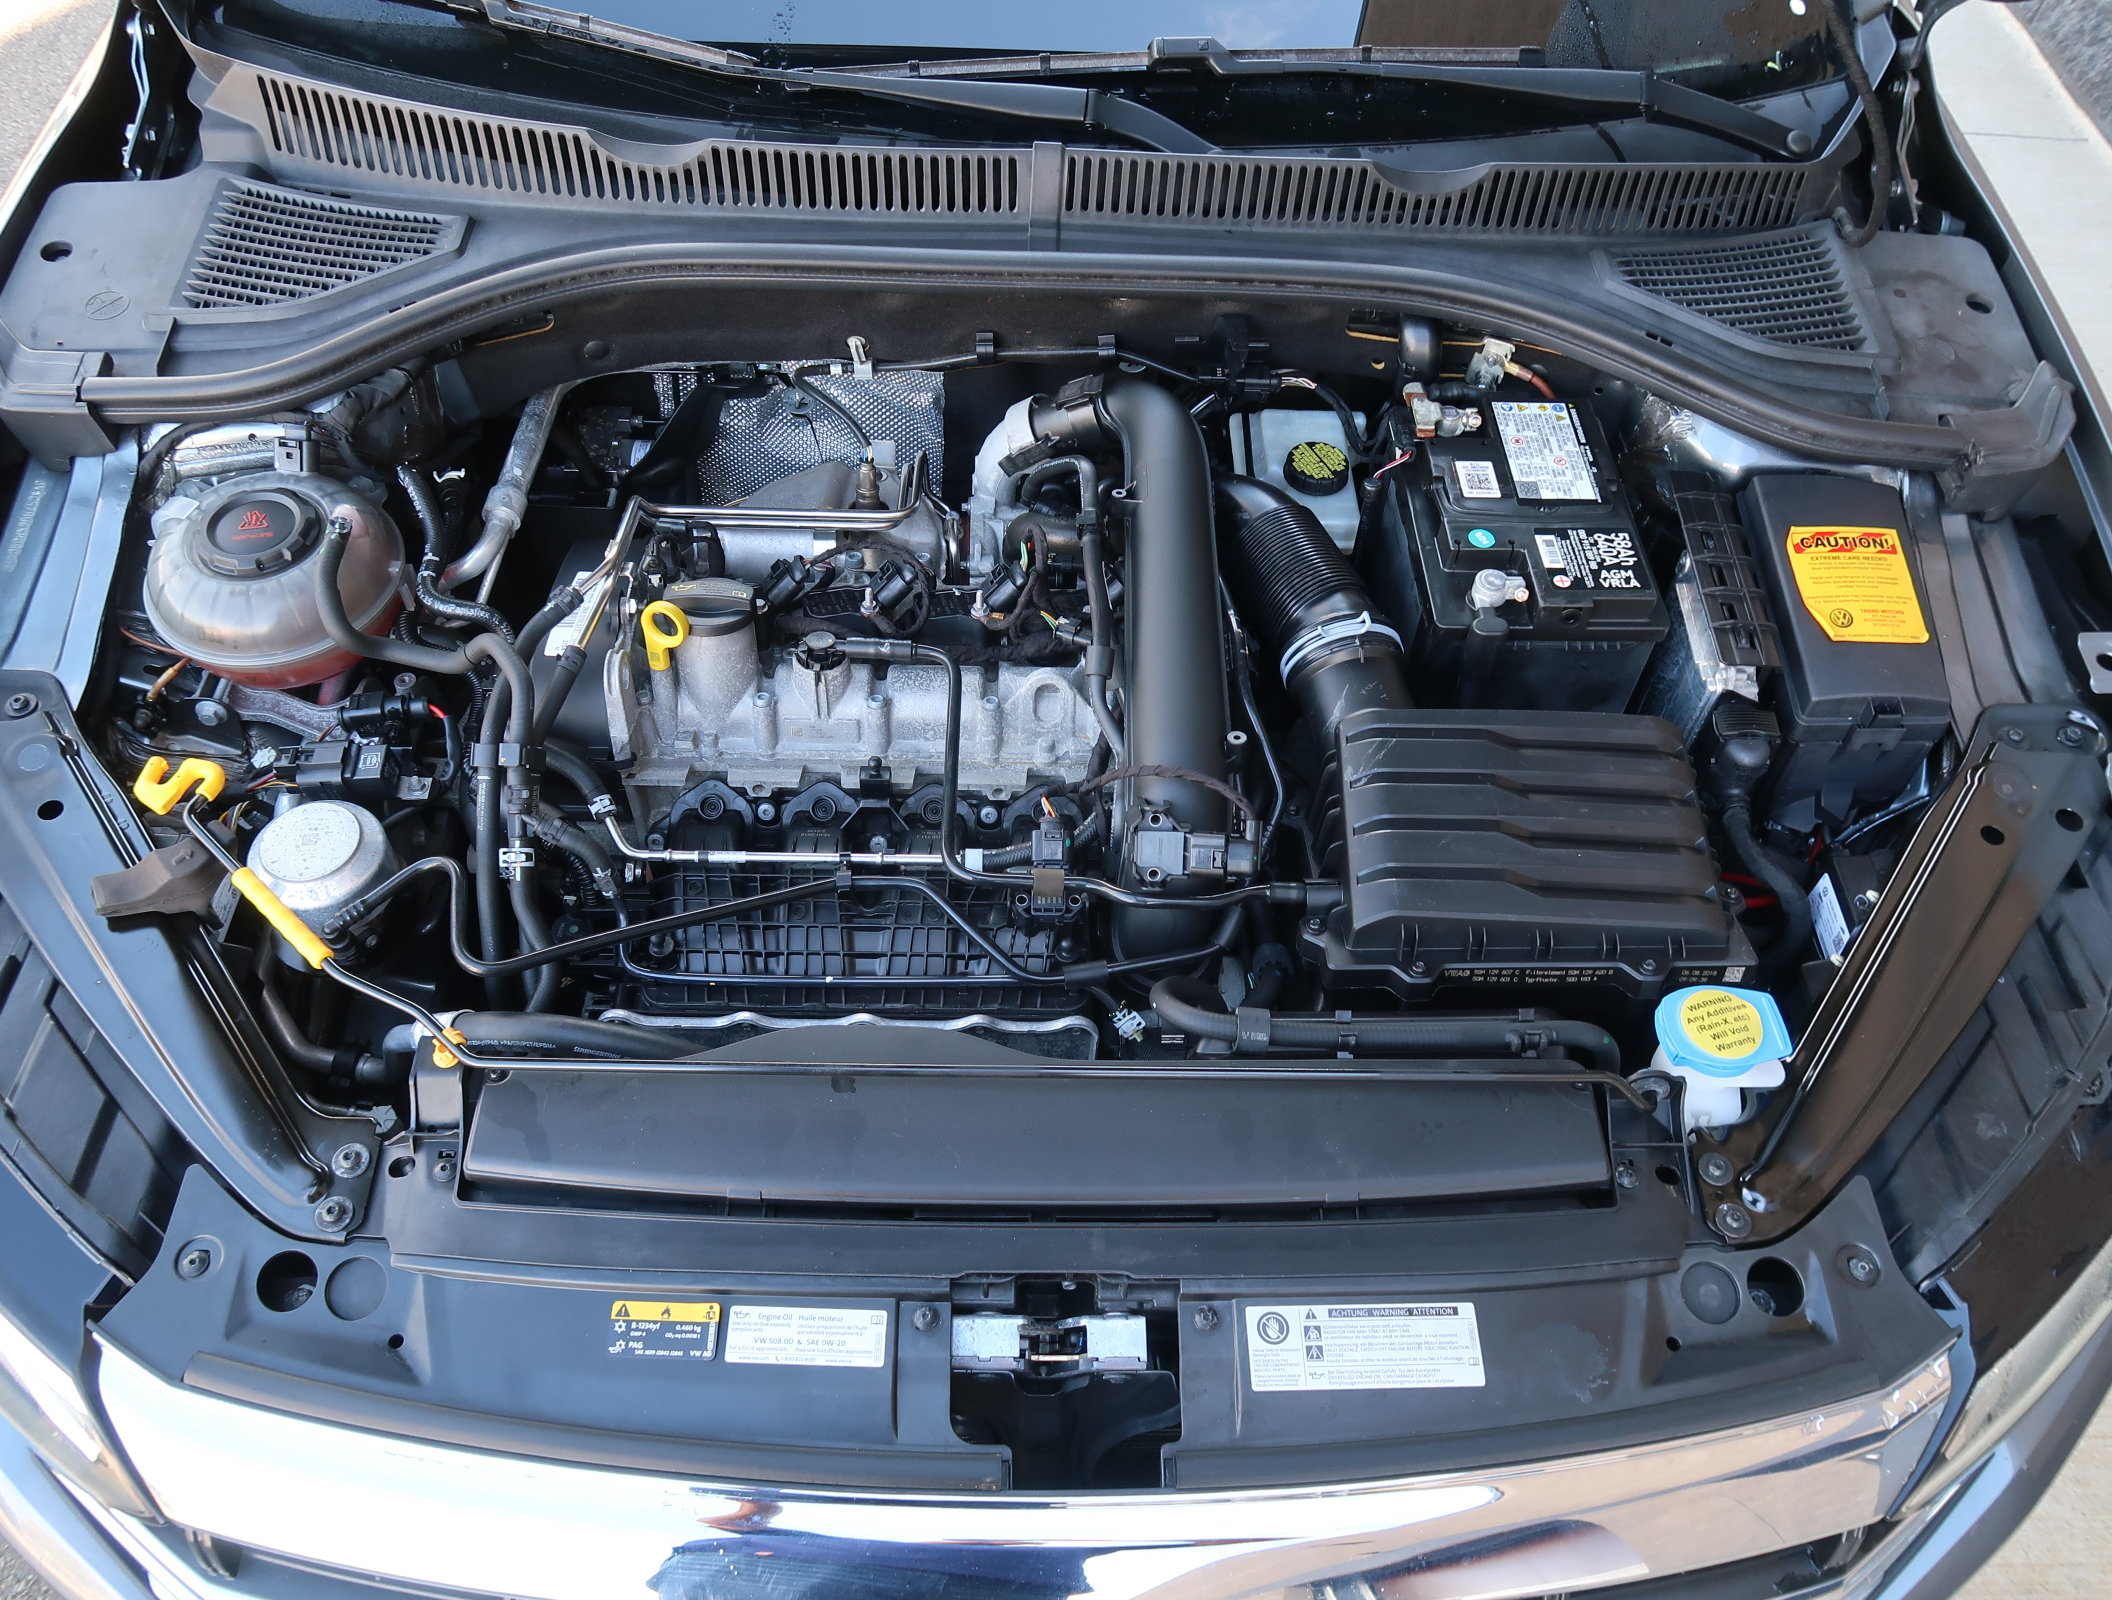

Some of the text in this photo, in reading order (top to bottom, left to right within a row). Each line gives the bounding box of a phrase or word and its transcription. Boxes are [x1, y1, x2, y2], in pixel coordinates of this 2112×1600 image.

[1800, 536, 1890, 550] CAUTION!
[1593, 533, 1620, 566] 640A
[1611, 533, 1638, 566] 58Ah
[1600, 569, 1635, 579] AGM
[1599, 579, 1641, 587] VRLA
[1687, 995, 1732, 1012] WARNING
[1687, 1003, 1747, 1025] Any Additives
[1733, 1013, 1751, 1024] etc)
[1709, 1025, 1750, 1041] Will Void
[1715, 1036, 1756, 1052] Warranty
[758, 1313, 781, 1322] Engine
[1331, 1307, 1454, 1317] ACHTUNG WARNING ATTENTION
[631, 1322, 661, 1331] R-1234yf
[628, 1341, 643, 1349] PAG
[806, 1338, 820, 1346] SAE
[822, 1339, 846, 1347] 0W-20
